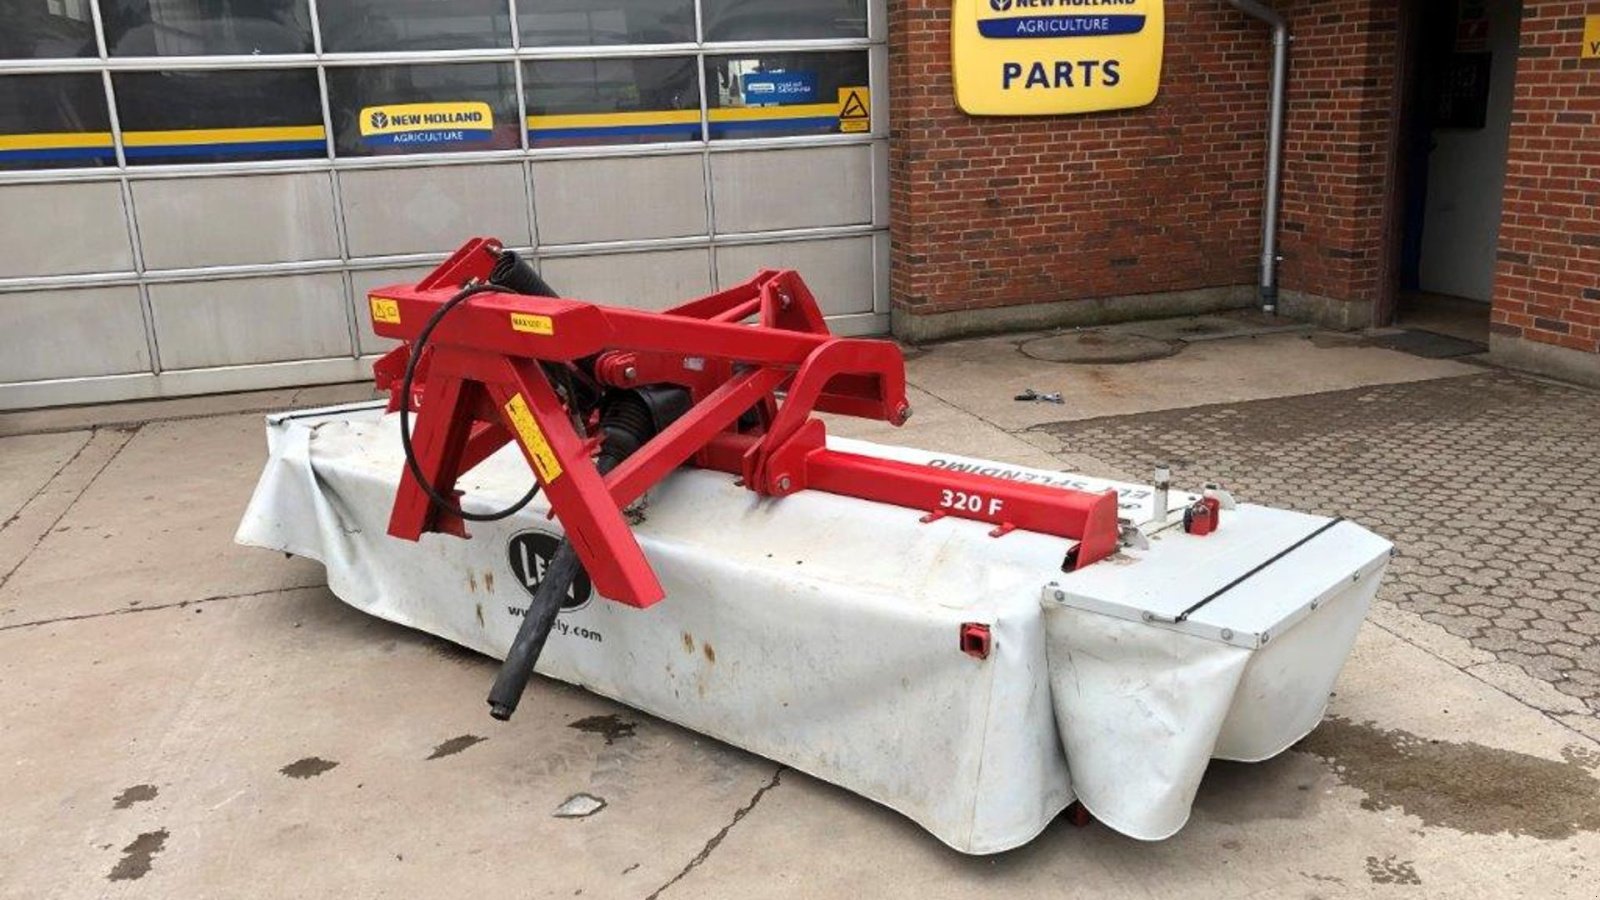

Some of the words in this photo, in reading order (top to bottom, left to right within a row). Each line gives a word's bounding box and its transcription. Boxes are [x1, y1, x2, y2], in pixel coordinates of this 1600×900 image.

[1017, 18, 1109, 33] AGRICULTURE
[1002, 59, 1120, 90] PARTS
[390, 115, 421, 126] NEW
[424, 111, 483, 124] HOLLAND
[393, 130, 464, 143] AGRICULTURE
[939, 489, 983, 513] 320
[988, 498, 1004, 516] F
